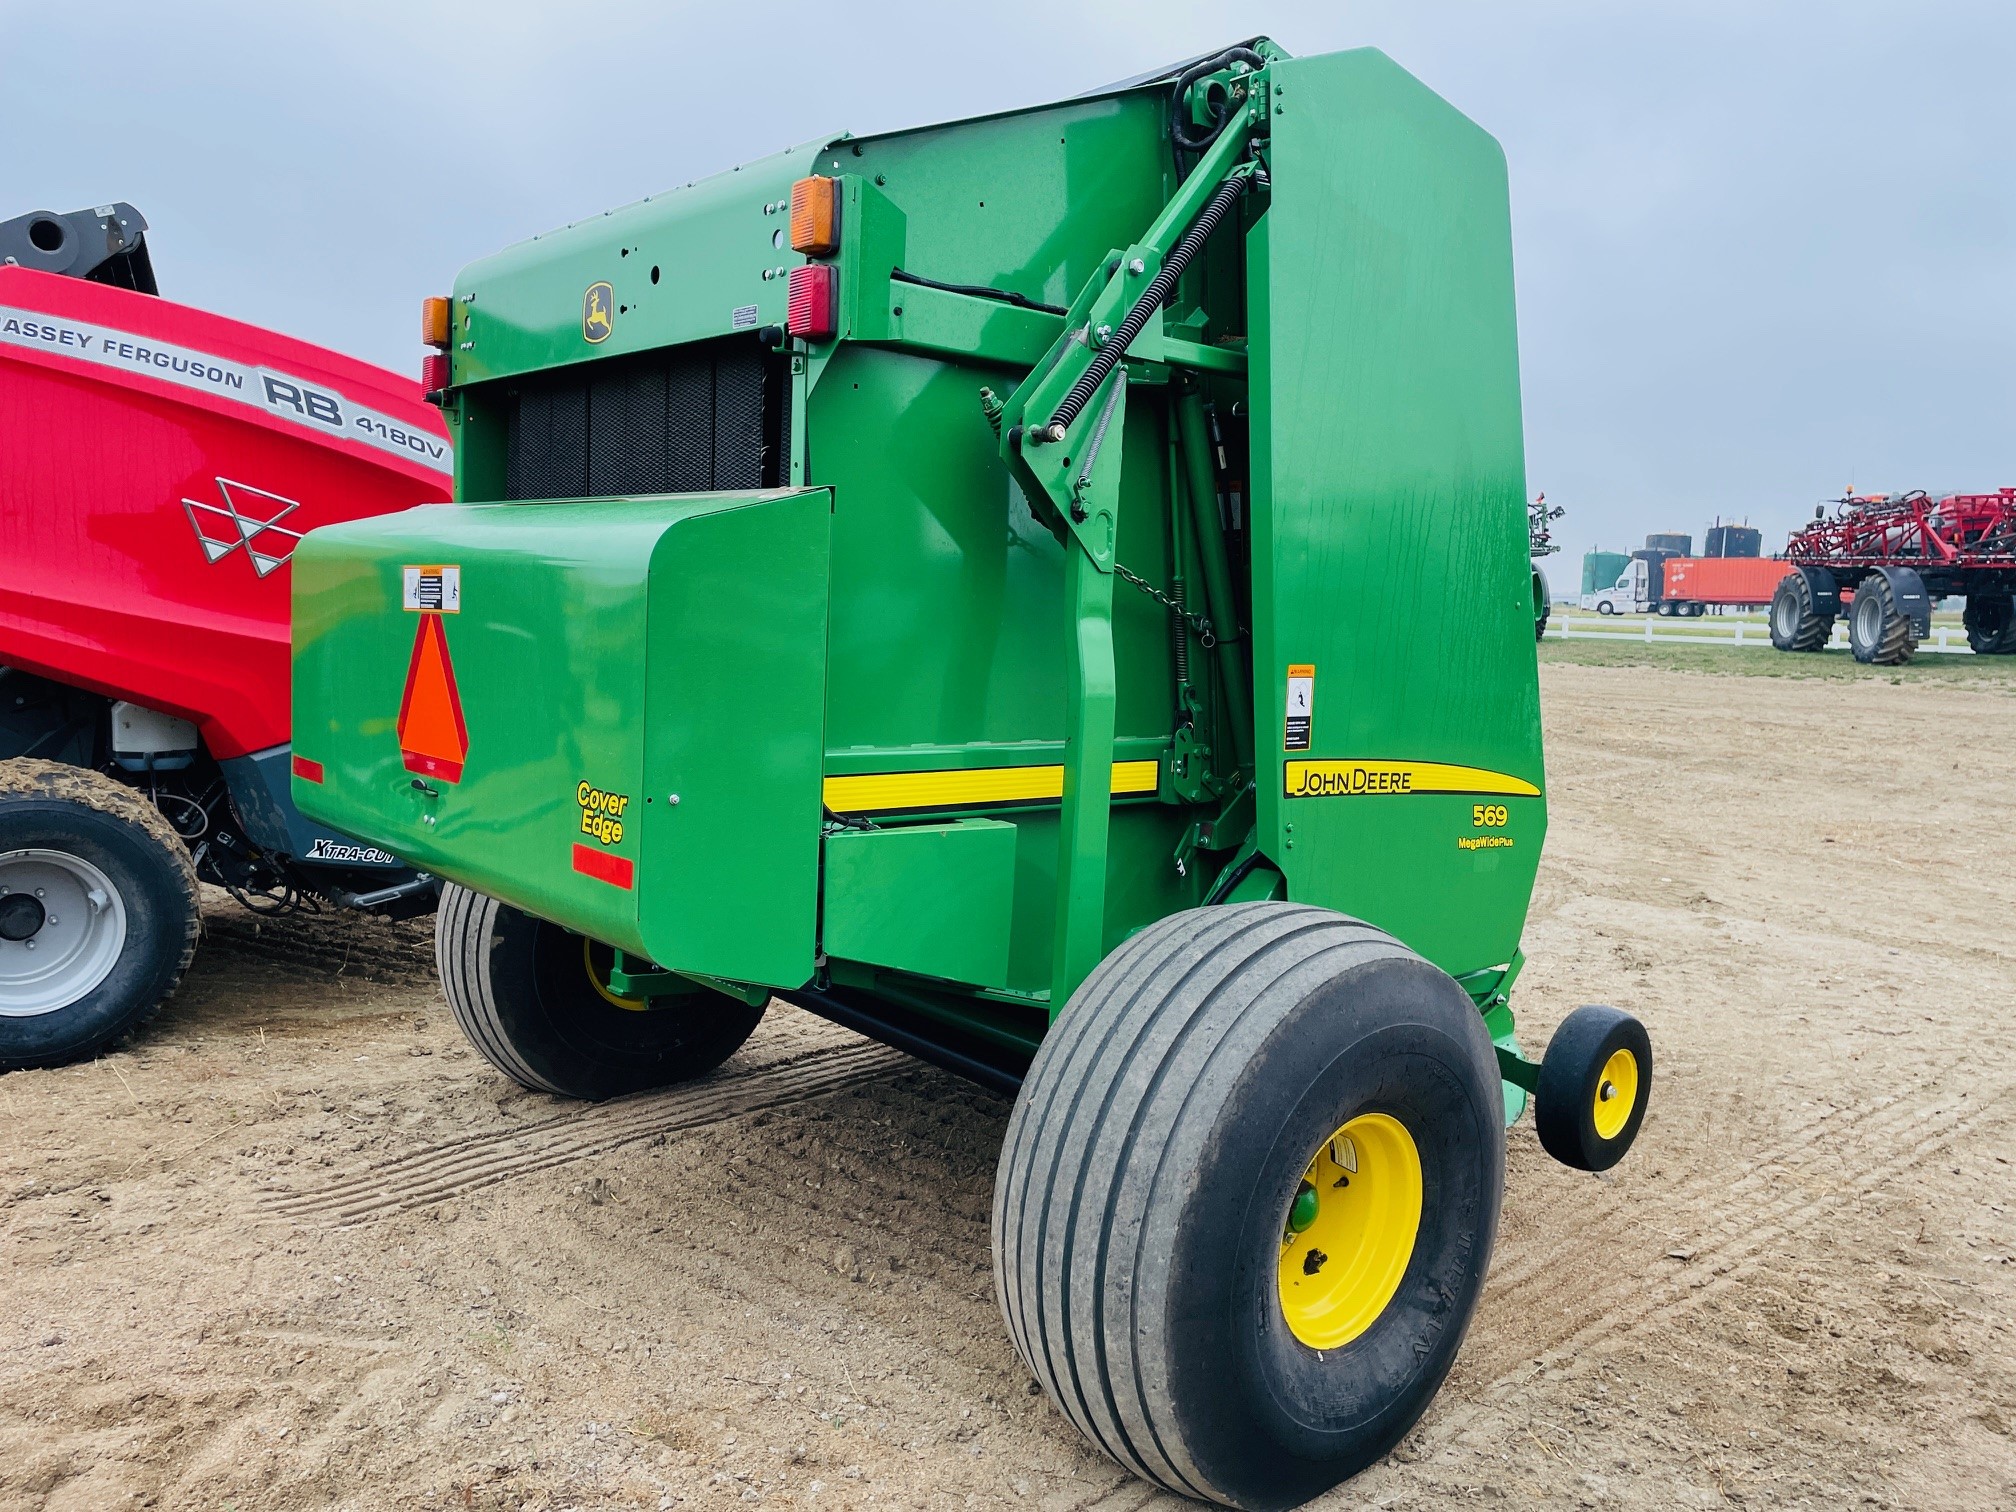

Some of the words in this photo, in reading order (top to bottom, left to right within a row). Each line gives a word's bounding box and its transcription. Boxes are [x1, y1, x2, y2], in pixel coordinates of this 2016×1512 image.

[0, 317, 93, 348] ASSEY
[102, 339, 243, 389] FERGUSON
[262, 376, 343, 426] RB
[356, 417, 444, 459] 4180V
[1296, 769, 1349, 793] JOHN
[1352, 768, 1412, 791] DEERE
[577, 780, 629, 818] Cover
[581, 808, 623, 846] Edge
[1473, 805, 1508, 828] 569
[1458, 836, 1514, 850] MegaWidePlus
